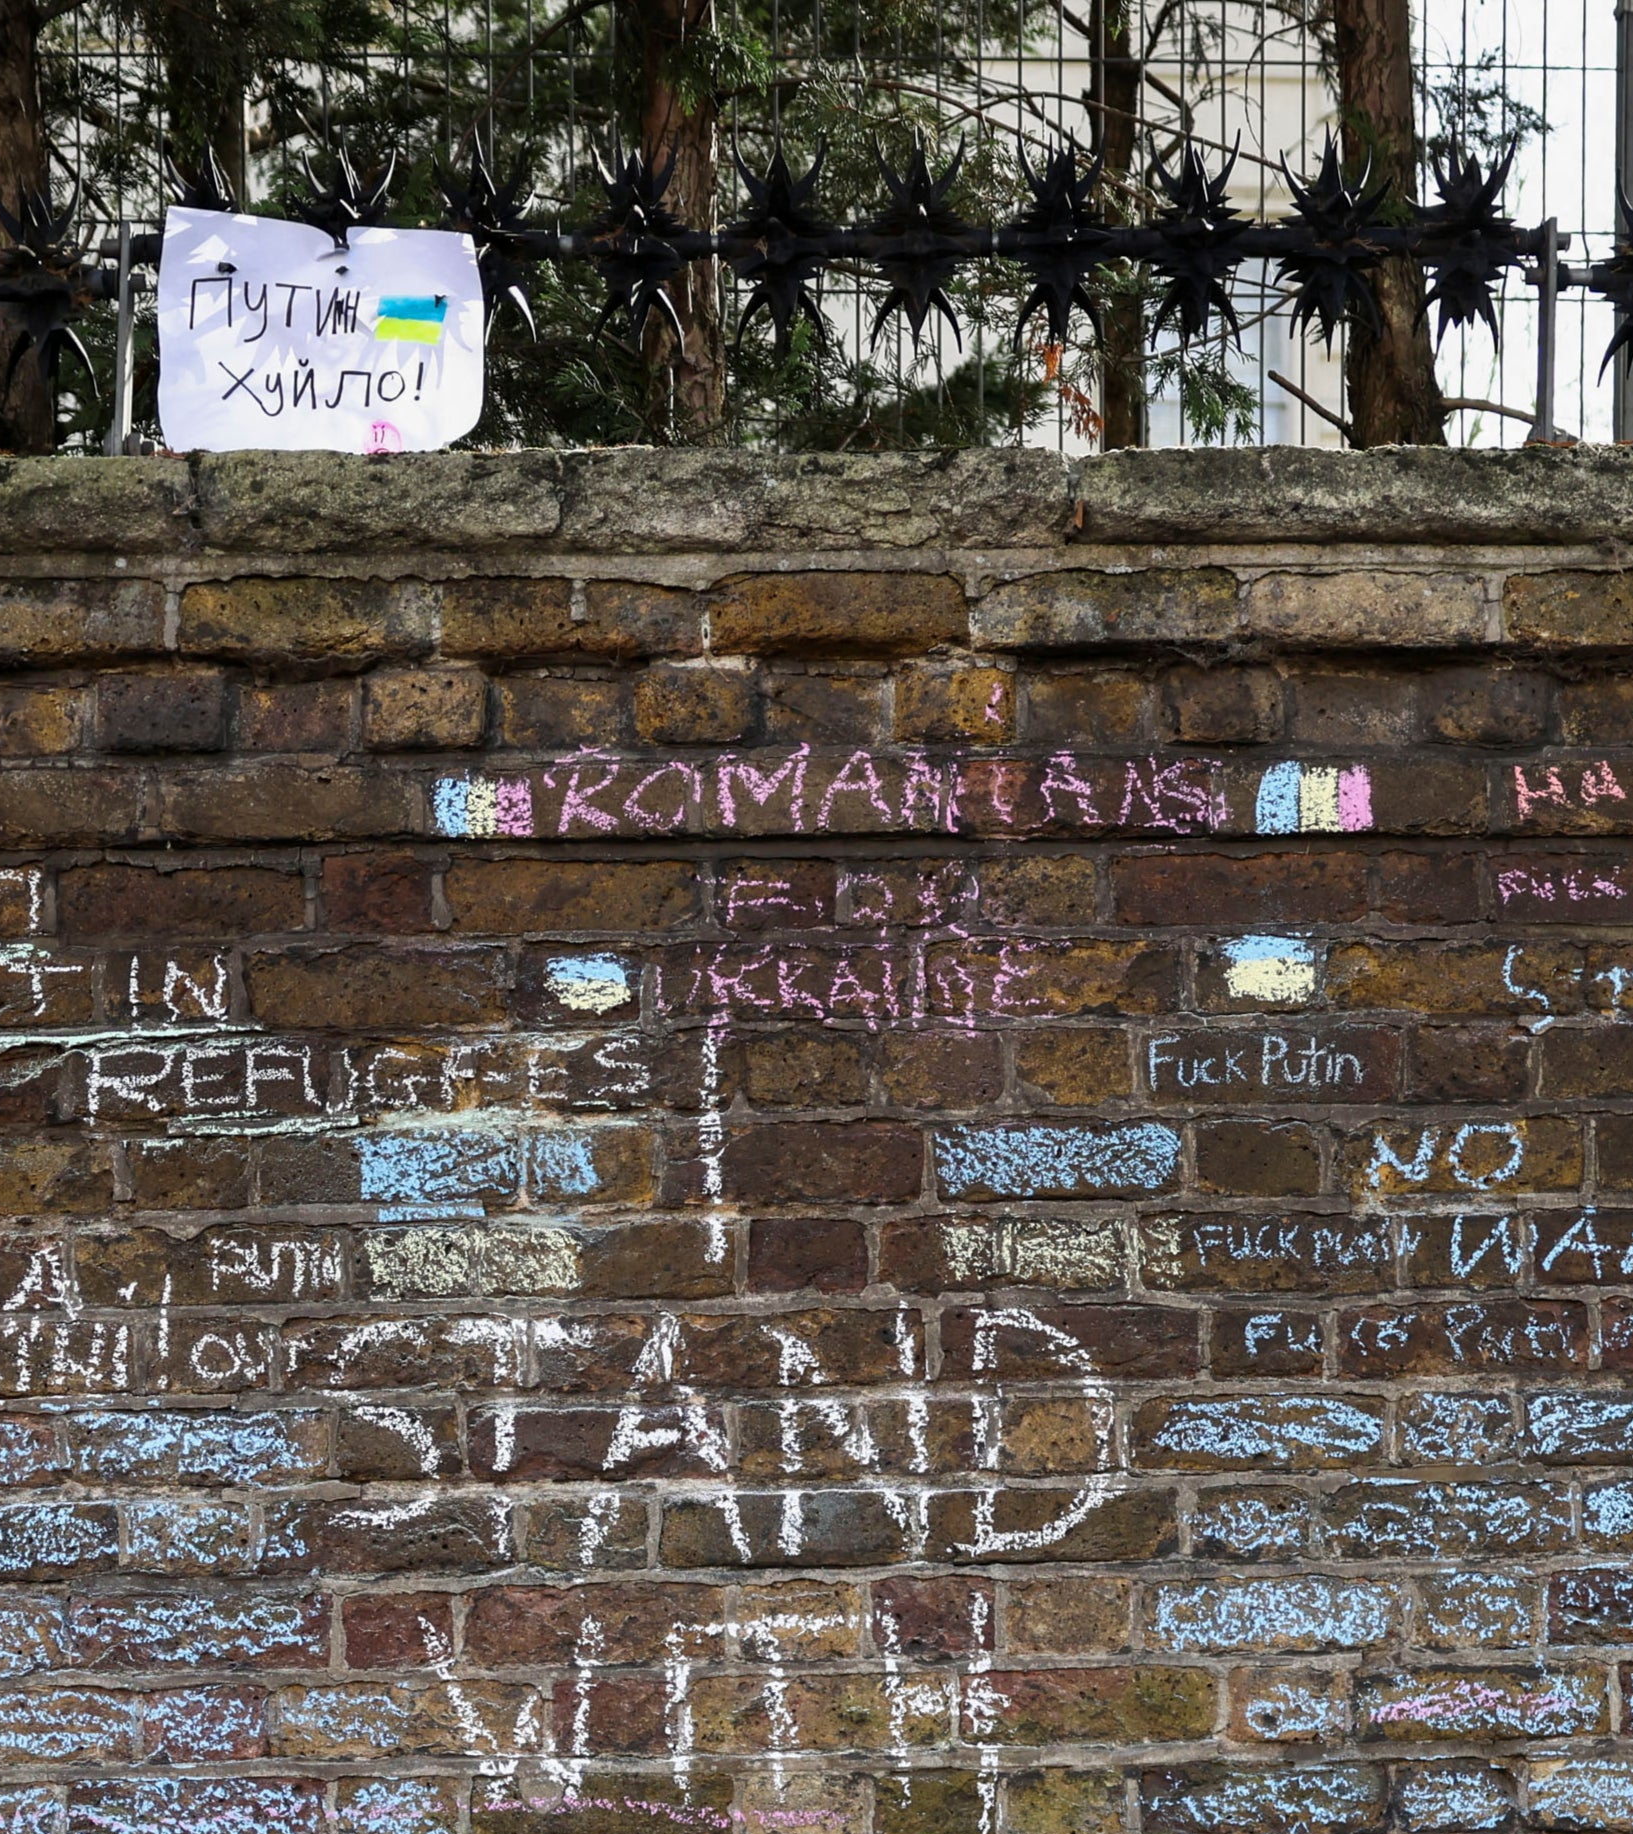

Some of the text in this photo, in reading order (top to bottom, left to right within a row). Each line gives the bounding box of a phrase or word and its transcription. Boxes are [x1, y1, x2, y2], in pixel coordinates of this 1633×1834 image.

[218, 358, 425, 417] ХУЙЛО!
[128, 953, 228, 1024] IN
[1366, 1118, 1525, 1190] NO
[325, 1300, 1131, 1566] STAND
